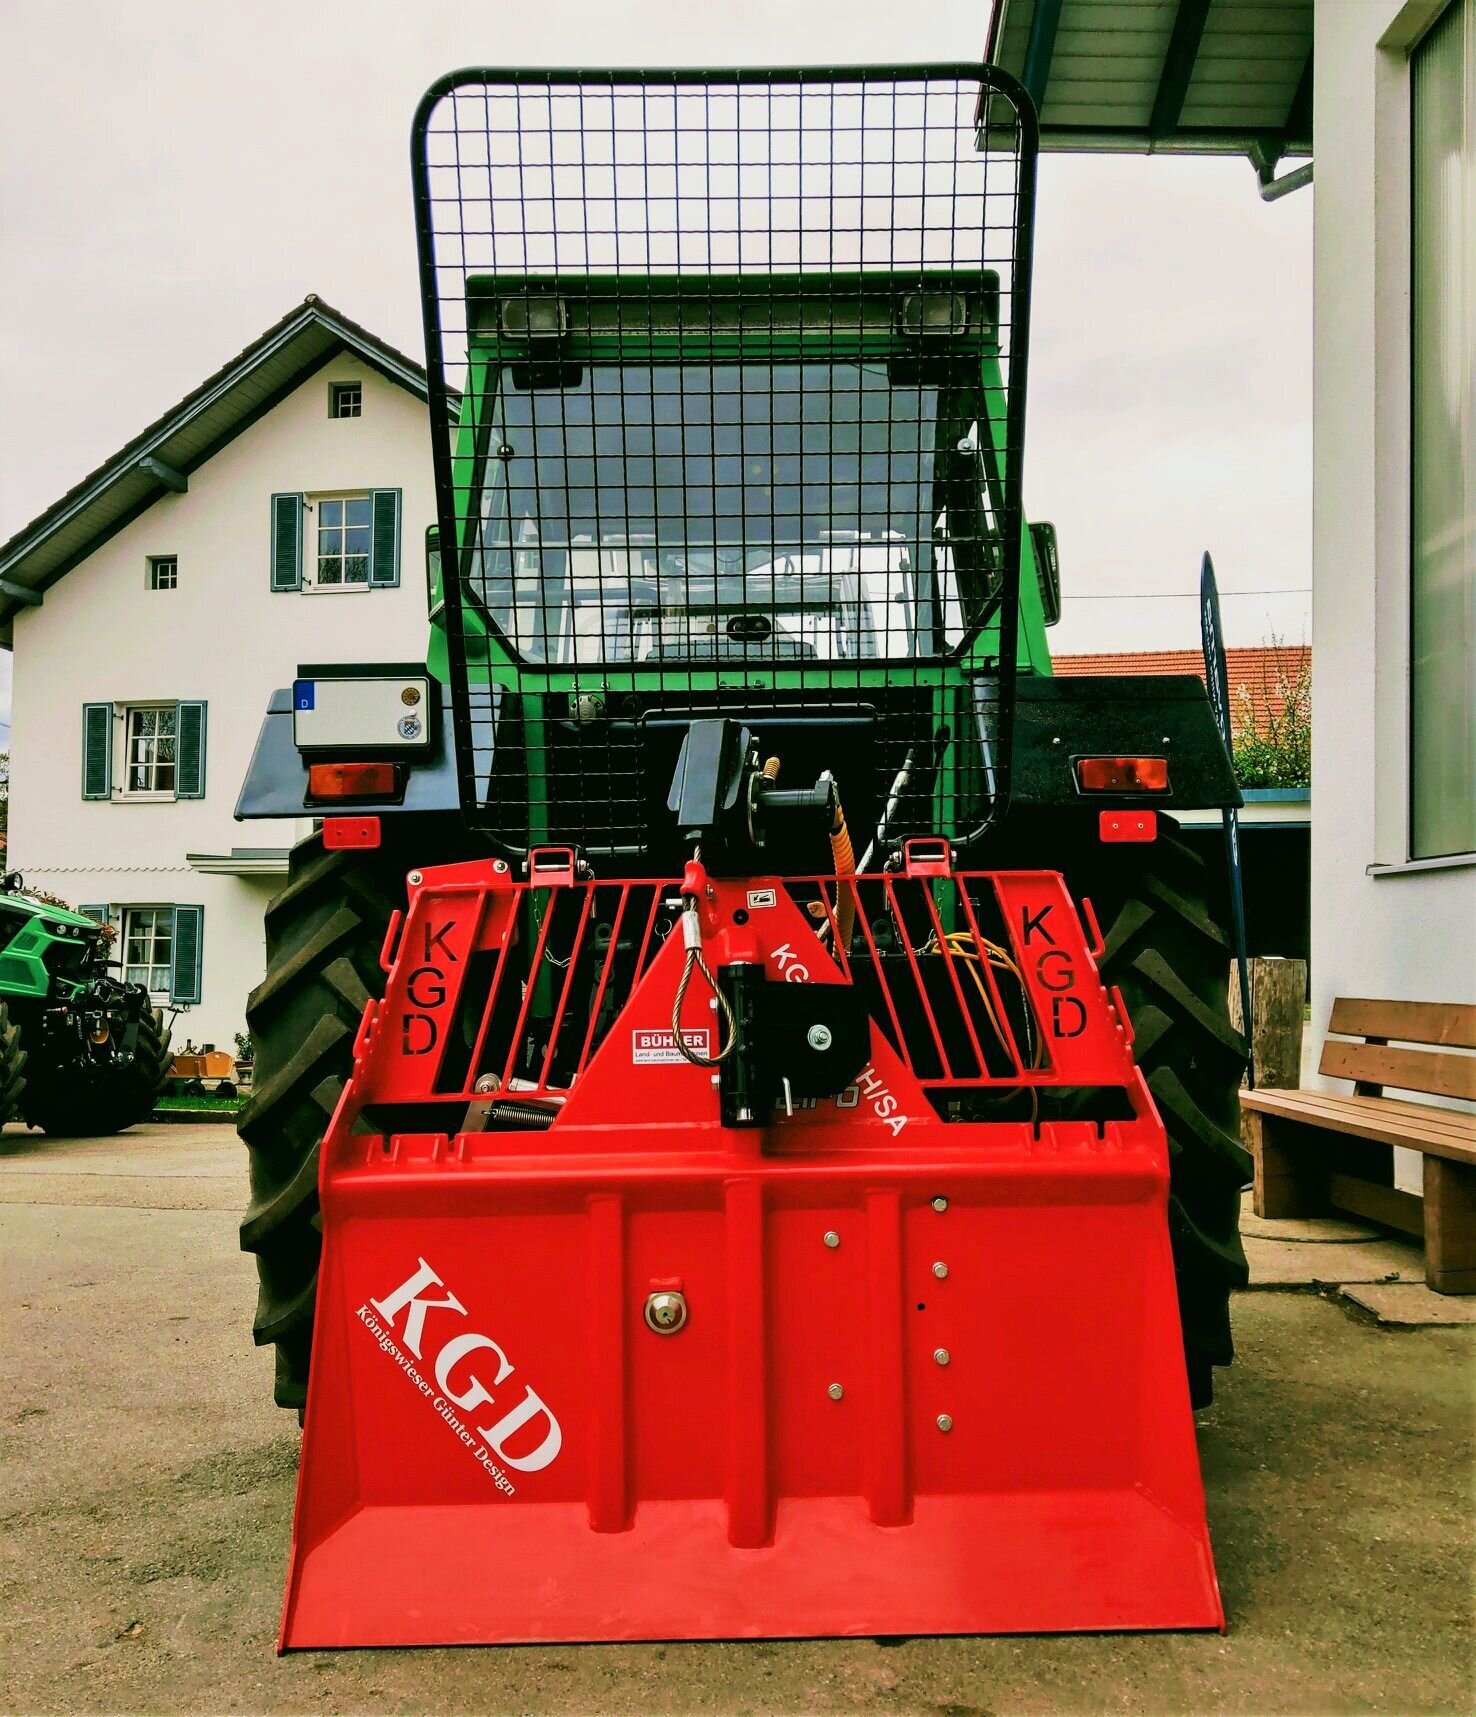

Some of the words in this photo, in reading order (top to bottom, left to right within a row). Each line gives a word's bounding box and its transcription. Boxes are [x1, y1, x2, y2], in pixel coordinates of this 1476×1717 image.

[301, 699, 309, 709] D
[402, 920, 459, 1056] KGD
[1022, 905, 1088, 1038] KGD
[640, 1034, 704, 1048] BÜHER
[770, 943, 816, 984] KG
[855, 1062, 908, 1137] H/SA
[355, 1304, 435, 1398] Königswieser
[433, 1396, 476, 1448] Günter
[473, 1445, 516, 1496] Design
[370, 1256, 563, 1472] KGD
